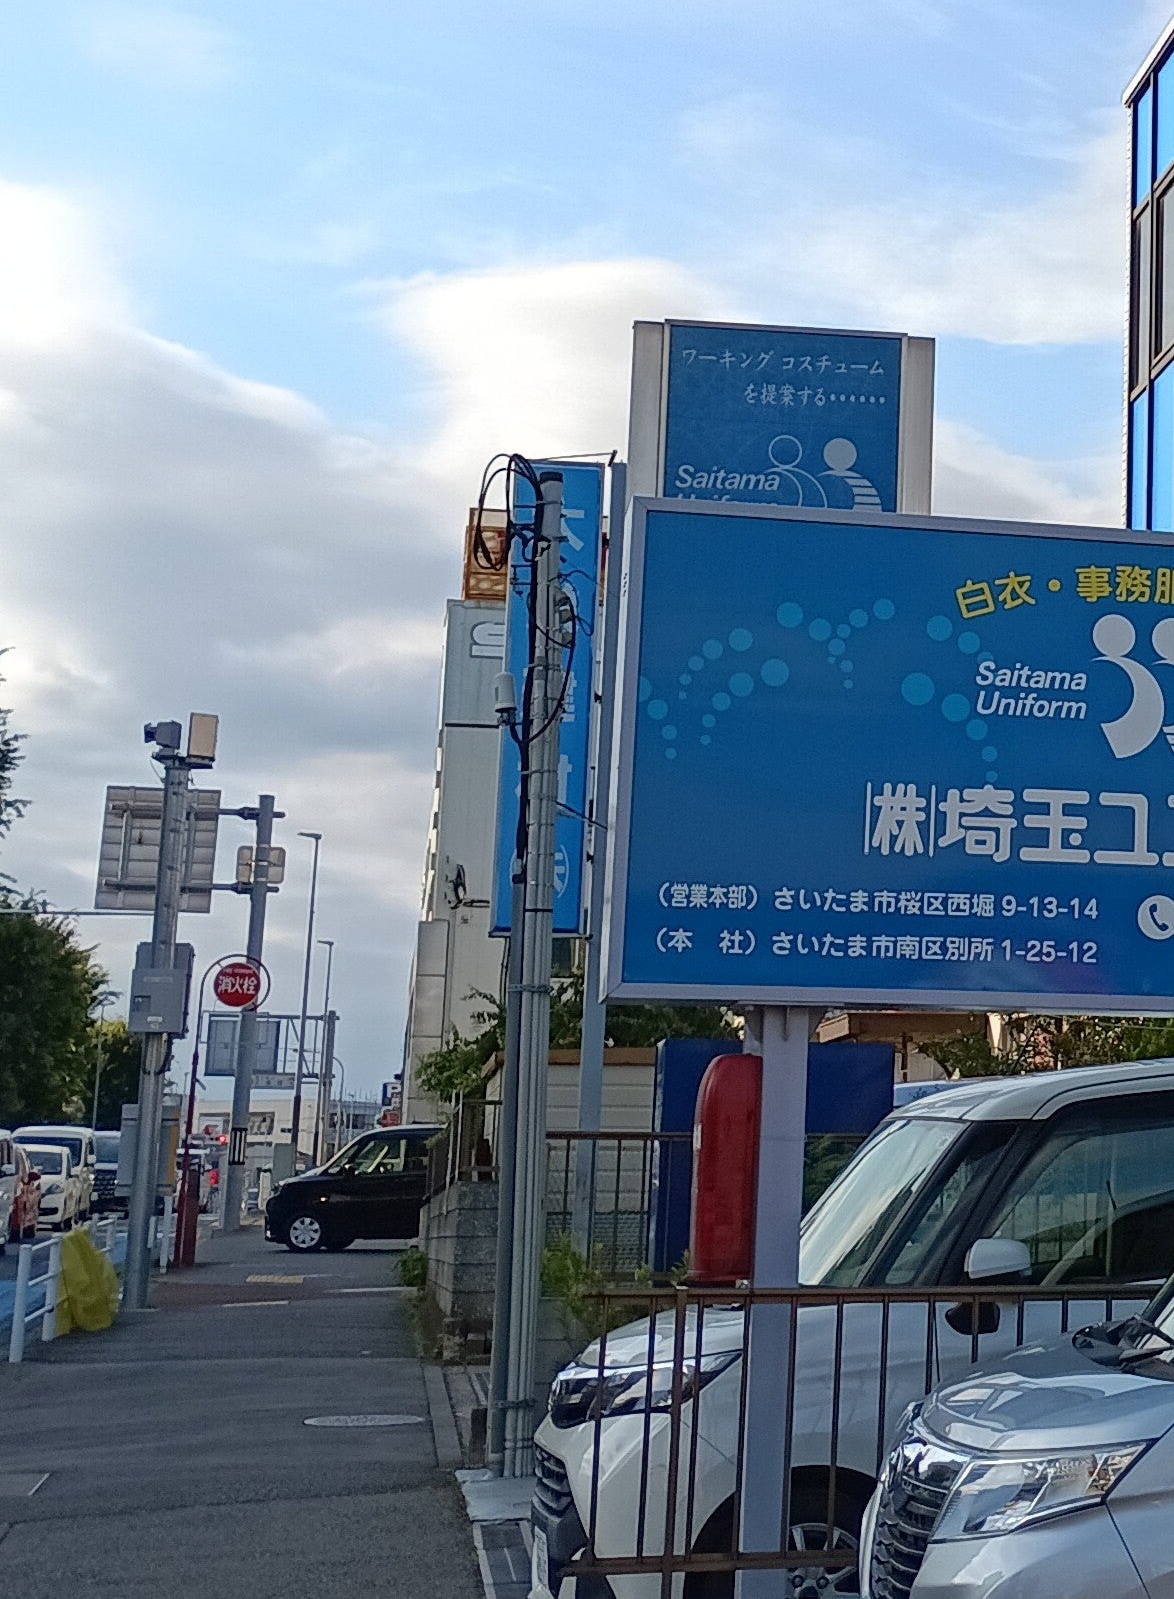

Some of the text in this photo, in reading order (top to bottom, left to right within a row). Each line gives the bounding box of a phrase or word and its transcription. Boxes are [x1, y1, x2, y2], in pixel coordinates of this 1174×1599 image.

[681, 349, 885, 377] ワーキング コスチューム
[674, 464, 781, 492] Saitama
[974, 660, 1088, 692] Saitama
[974, 692, 1088, 721] Uniform
[773, 886, 996, 918] さいたま市桜区西堀
[1000, 894, 1099, 921] 9-13-14
[771, 930, 995, 963] さいたま市南区別所
[999, 939, 1098, 965] 1-25-12
[217, 974, 258, 995] 消火栓
